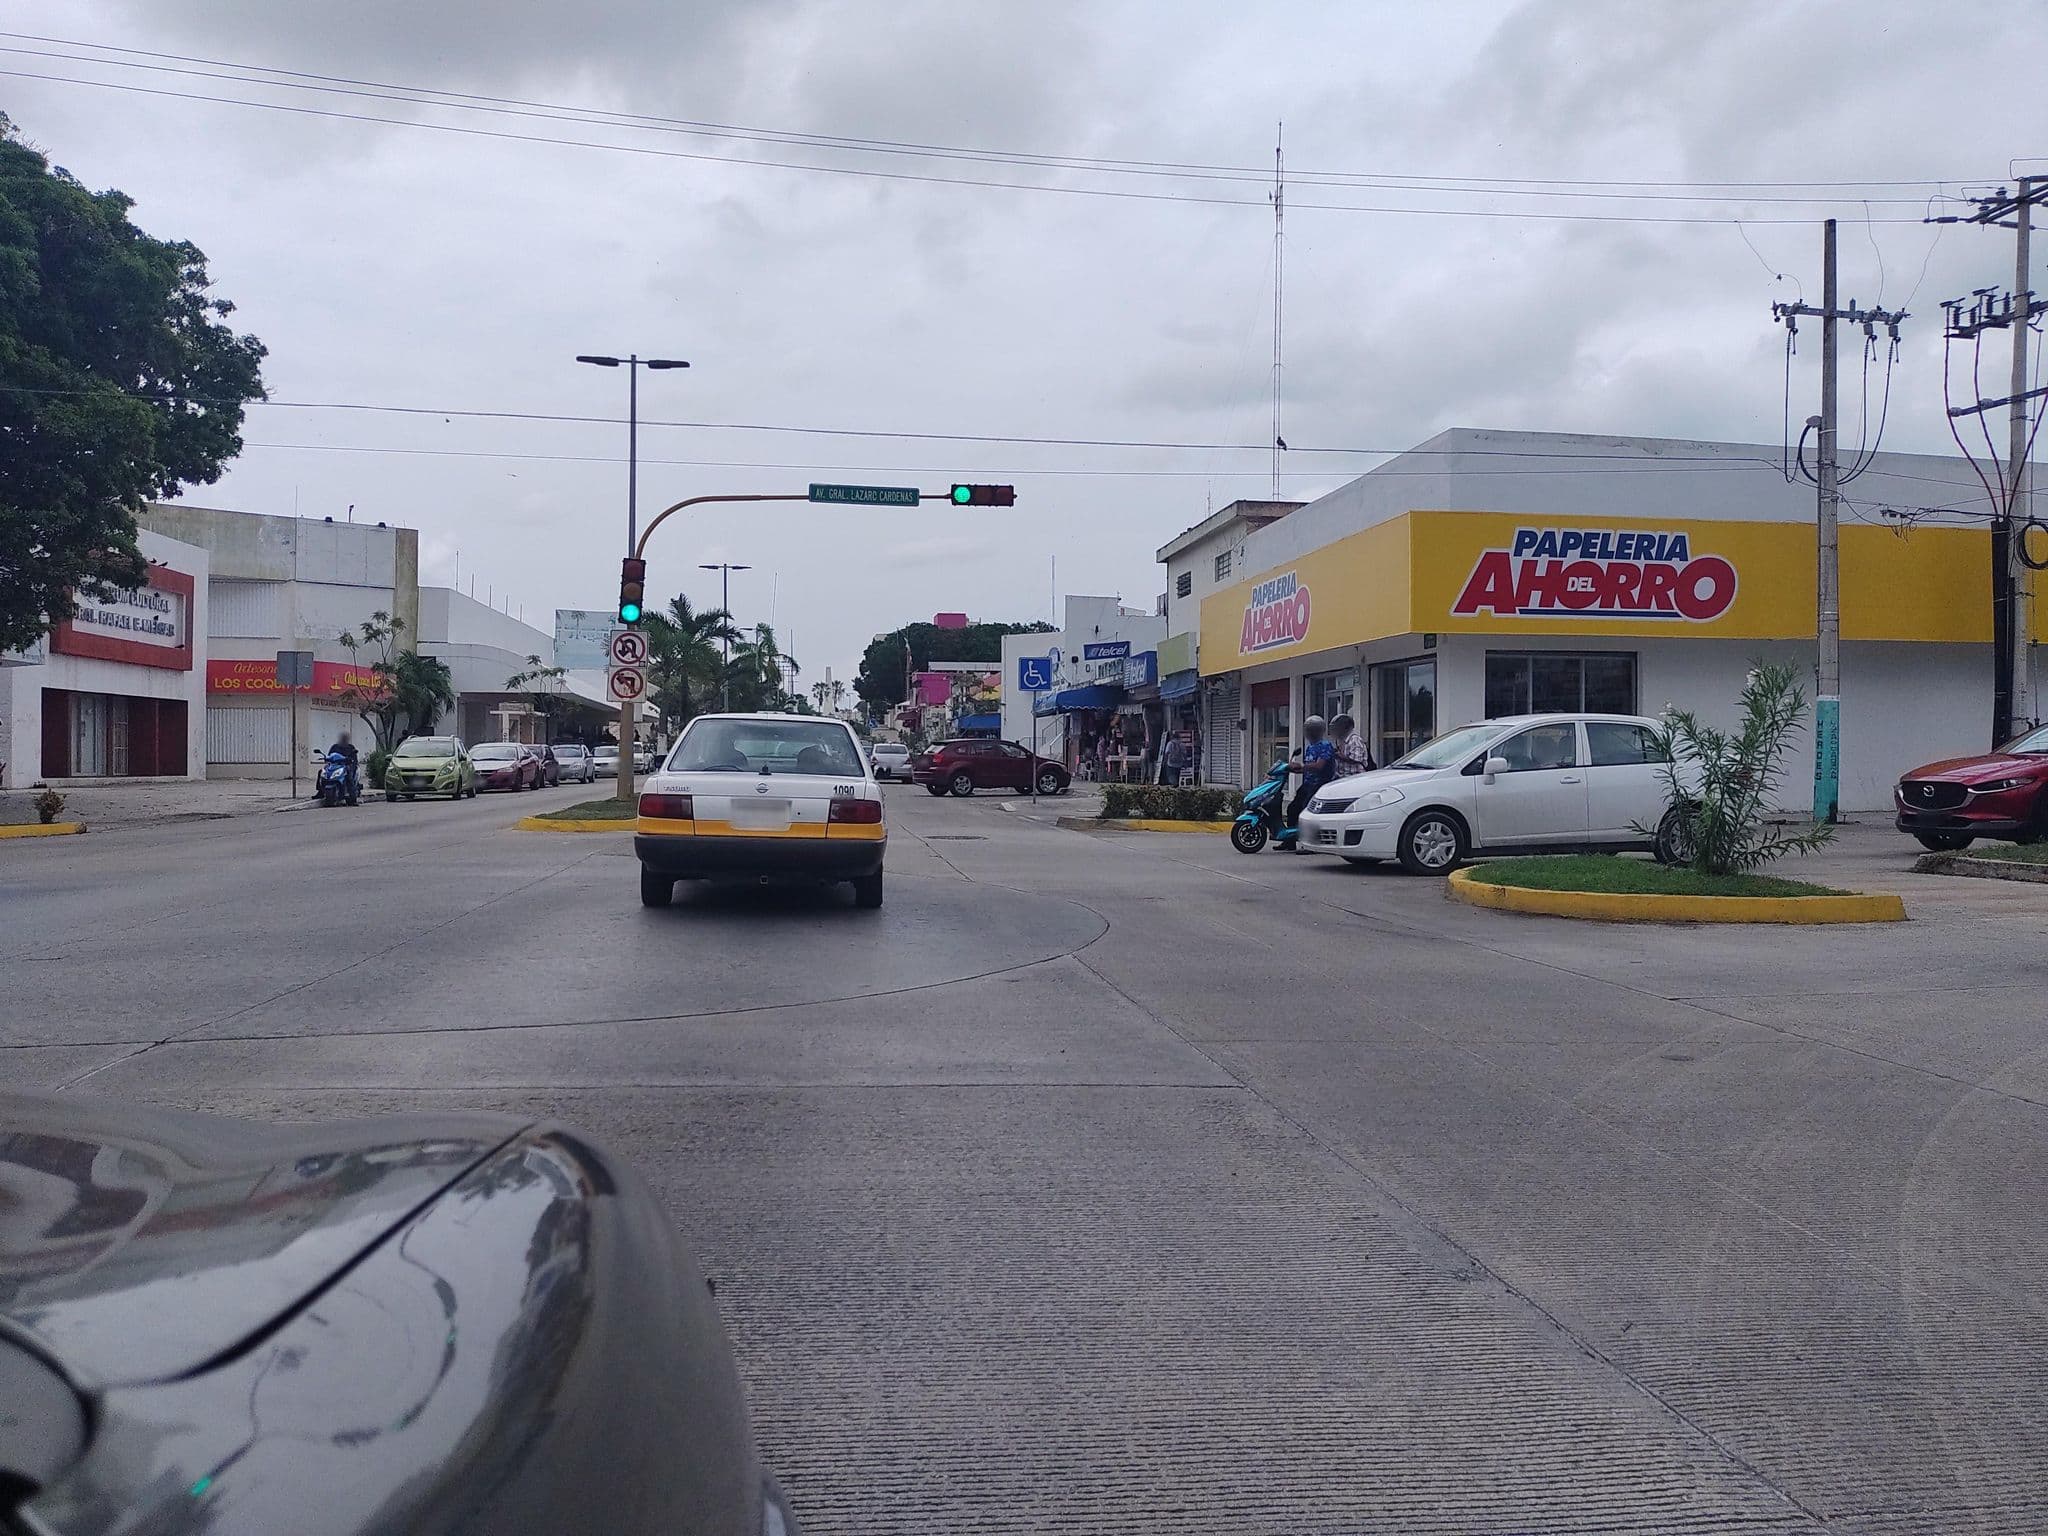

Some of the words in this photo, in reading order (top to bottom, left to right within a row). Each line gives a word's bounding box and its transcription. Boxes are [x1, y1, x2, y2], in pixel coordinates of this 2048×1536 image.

[815, 487, 826, 499] AV.
[828, 488, 849, 500] GRAL.
[880, 491, 913, 502] CARDENAS
[1513, 529, 1689, 562] PAPELERIA
[1251, 572, 1297, 608] PAPELERIA
[1452, 551, 1737, 620] AHORRO
[1566, 576, 1596, 593] DEL
[99, 611, 131, 629] RAFAEL
[1239, 586, 1311, 654] AHORRO
[1098, 645, 1127, 656] telcel
[214, 678, 240, 688] LOS
[833, 785, 855, 796] 1090
